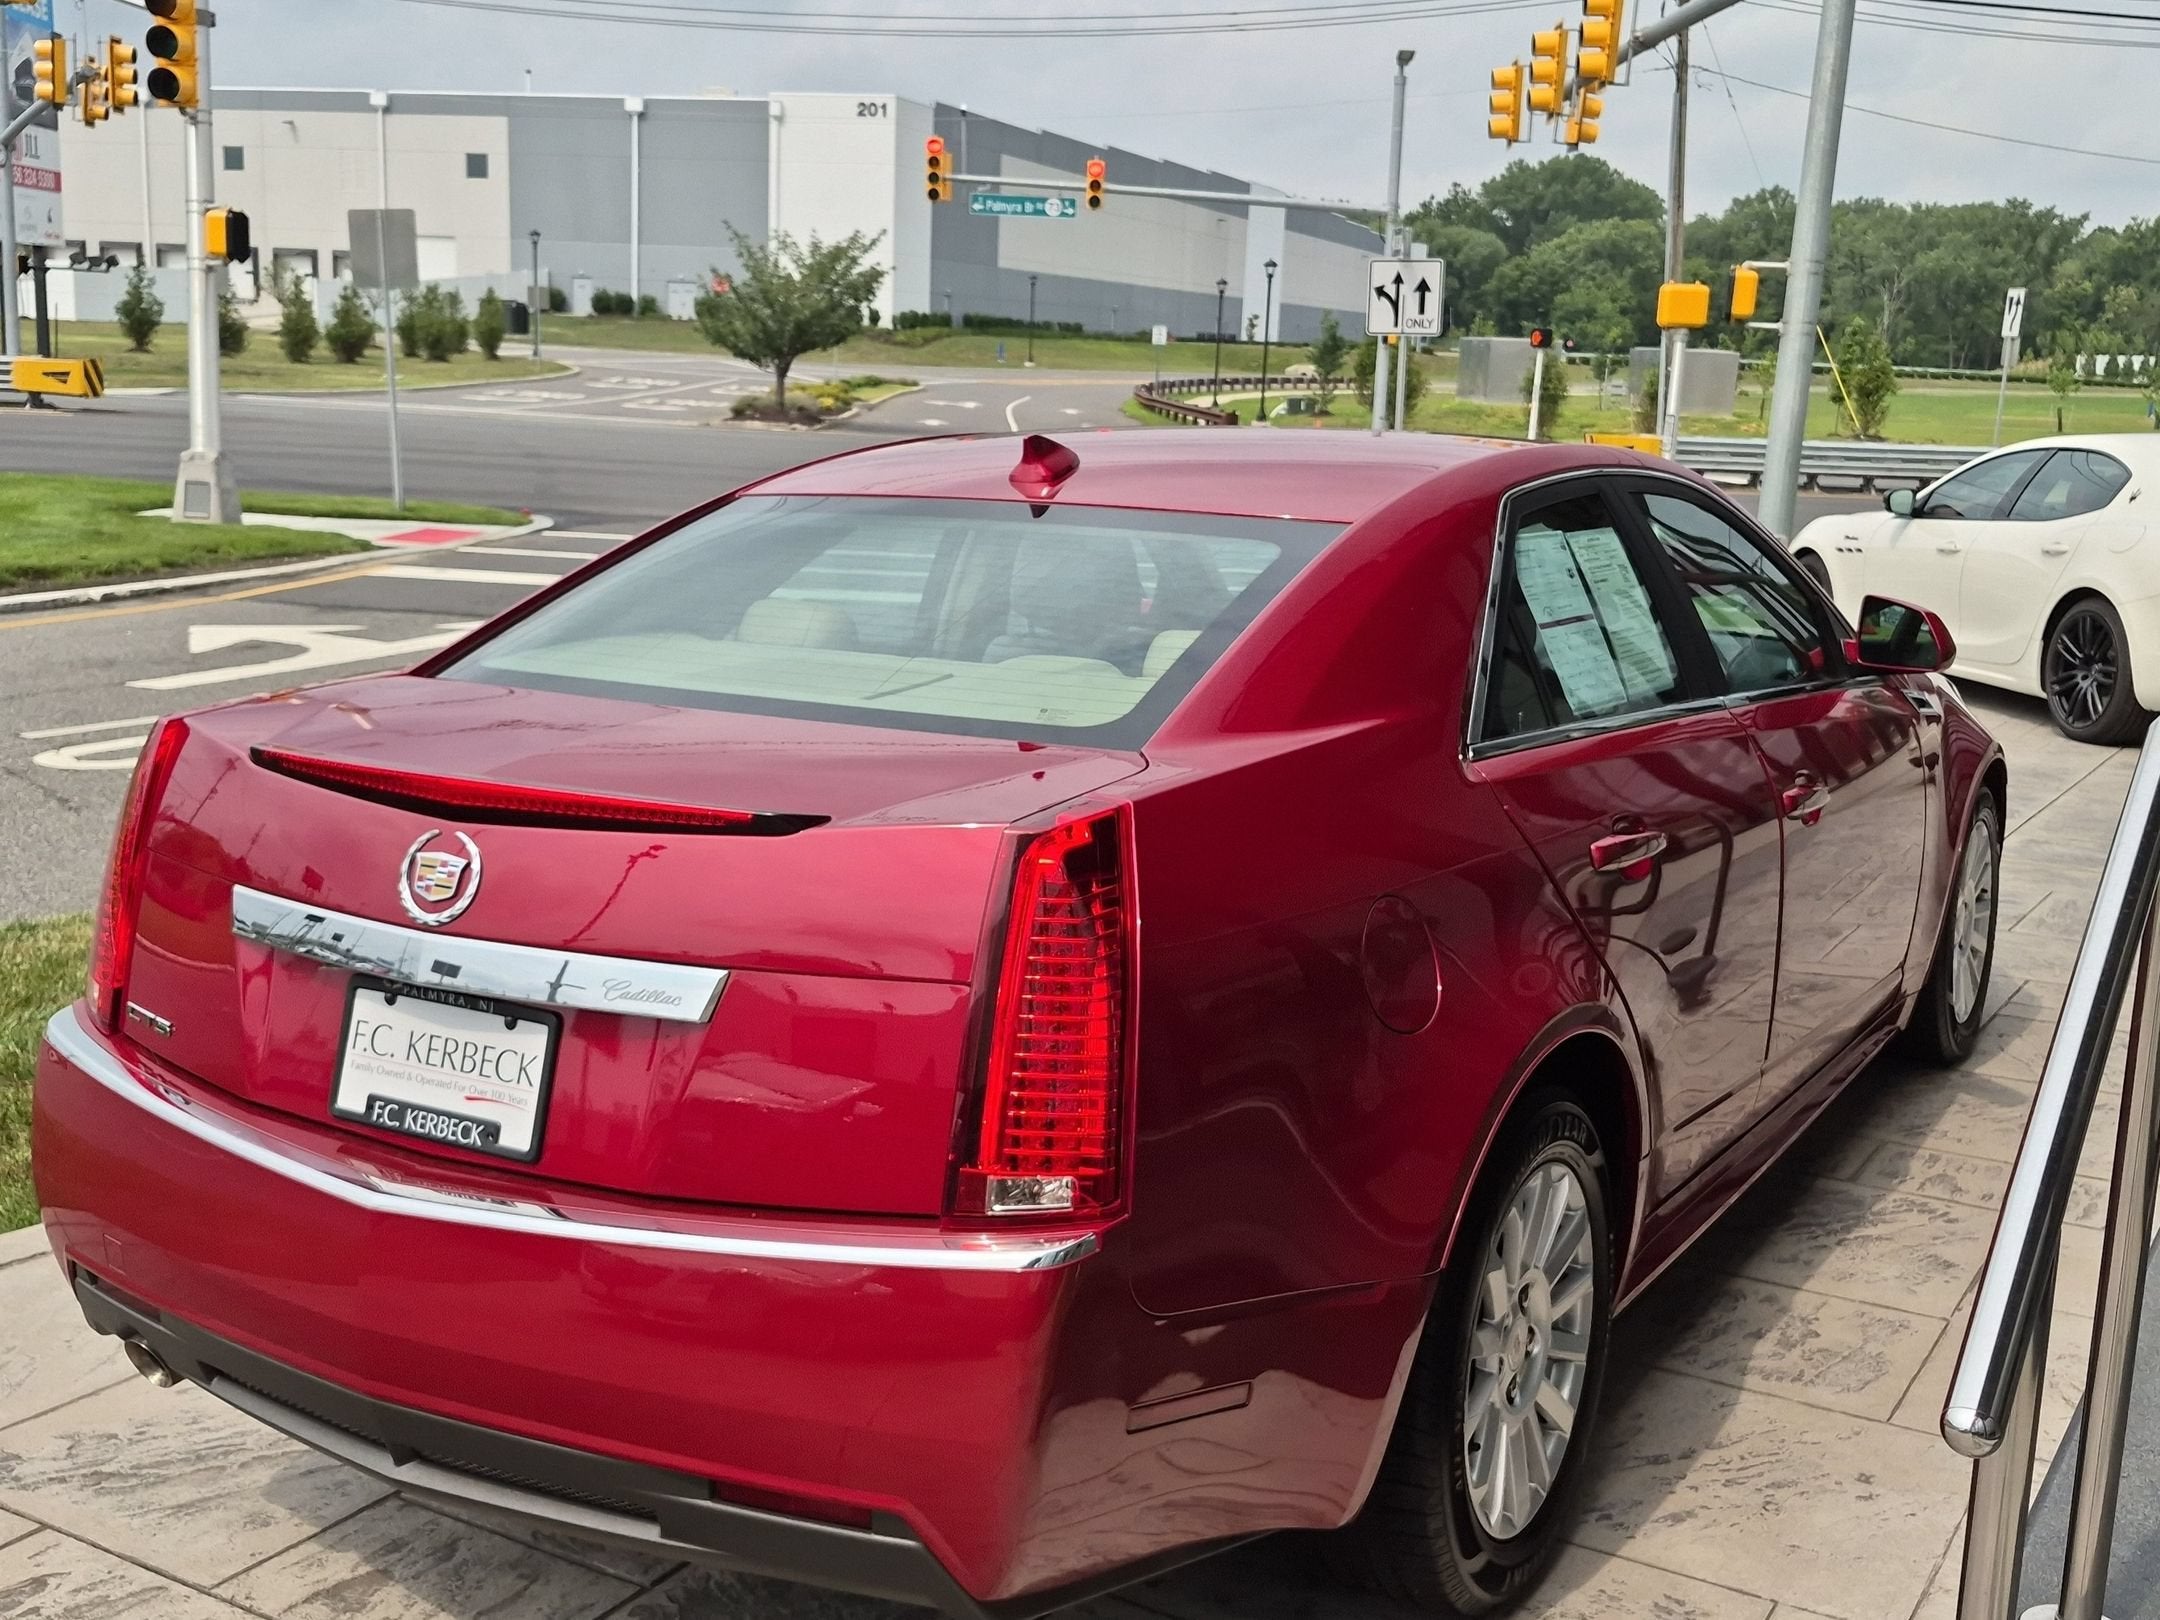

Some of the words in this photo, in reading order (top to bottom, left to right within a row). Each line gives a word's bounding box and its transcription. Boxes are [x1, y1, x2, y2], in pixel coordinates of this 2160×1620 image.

[857, 102, 888, 118] 201
[985, 200, 1023, 214] Palmyra
[1405, 318, 1434, 329] ONLY
[403, 985, 471, 1009] PALMYRA,
[479, 1001, 495, 1013] NJ
[602, 978, 683, 1006] Cadillac
[351, 1019, 395, 1059] F.C.
[406, 1030, 539, 1088] KERBECK
[350, 1059, 376, 1075] Family
[376, 1065, 406, 1081] Owned
[406, 1072, 413, 1082] &
[415, 1074, 452, 1091] Operated
[453, 1081, 467, 1093] For
[468, 1084, 489, 1097] Over
[491, 1088, 505, 1101] 100
[507, 1091, 528, 1106] Years
[371, 1100, 400, 1128] F.C.
[404, 1108, 485, 1147] KERBECK
